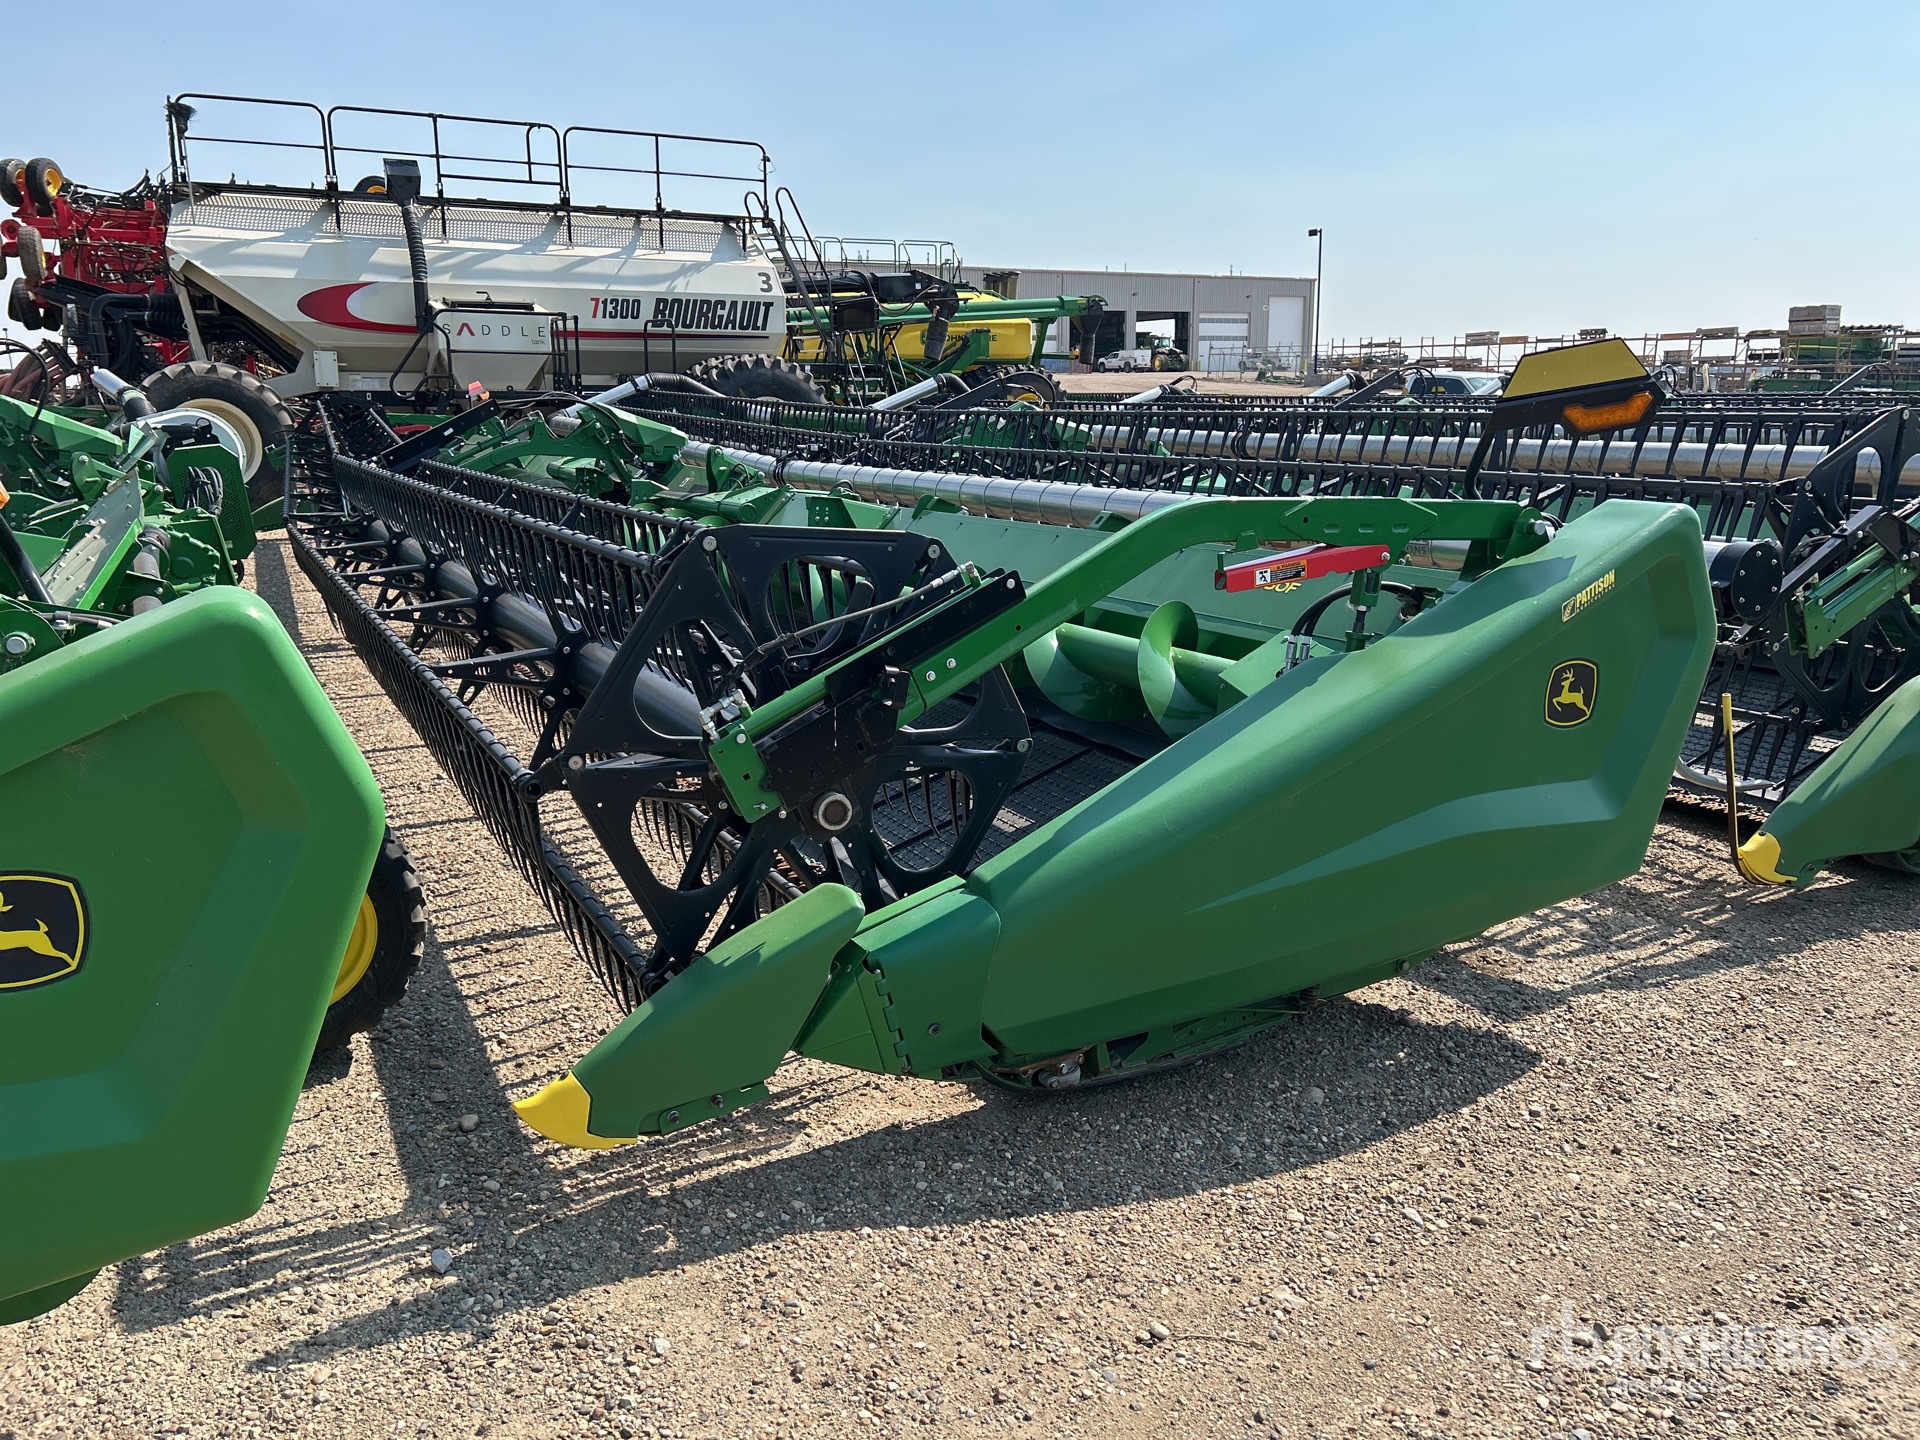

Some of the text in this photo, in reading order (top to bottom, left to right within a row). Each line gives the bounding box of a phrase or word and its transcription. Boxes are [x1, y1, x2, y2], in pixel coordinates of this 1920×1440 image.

[757, 272, 773, 293] 3
[590, 297, 641, 320] 71300
[651, 297, 775, 331] BOURGAULT
[442, 322, 546, 338] SADDLE
[1576, 569, 1615, 608] PATTISON
